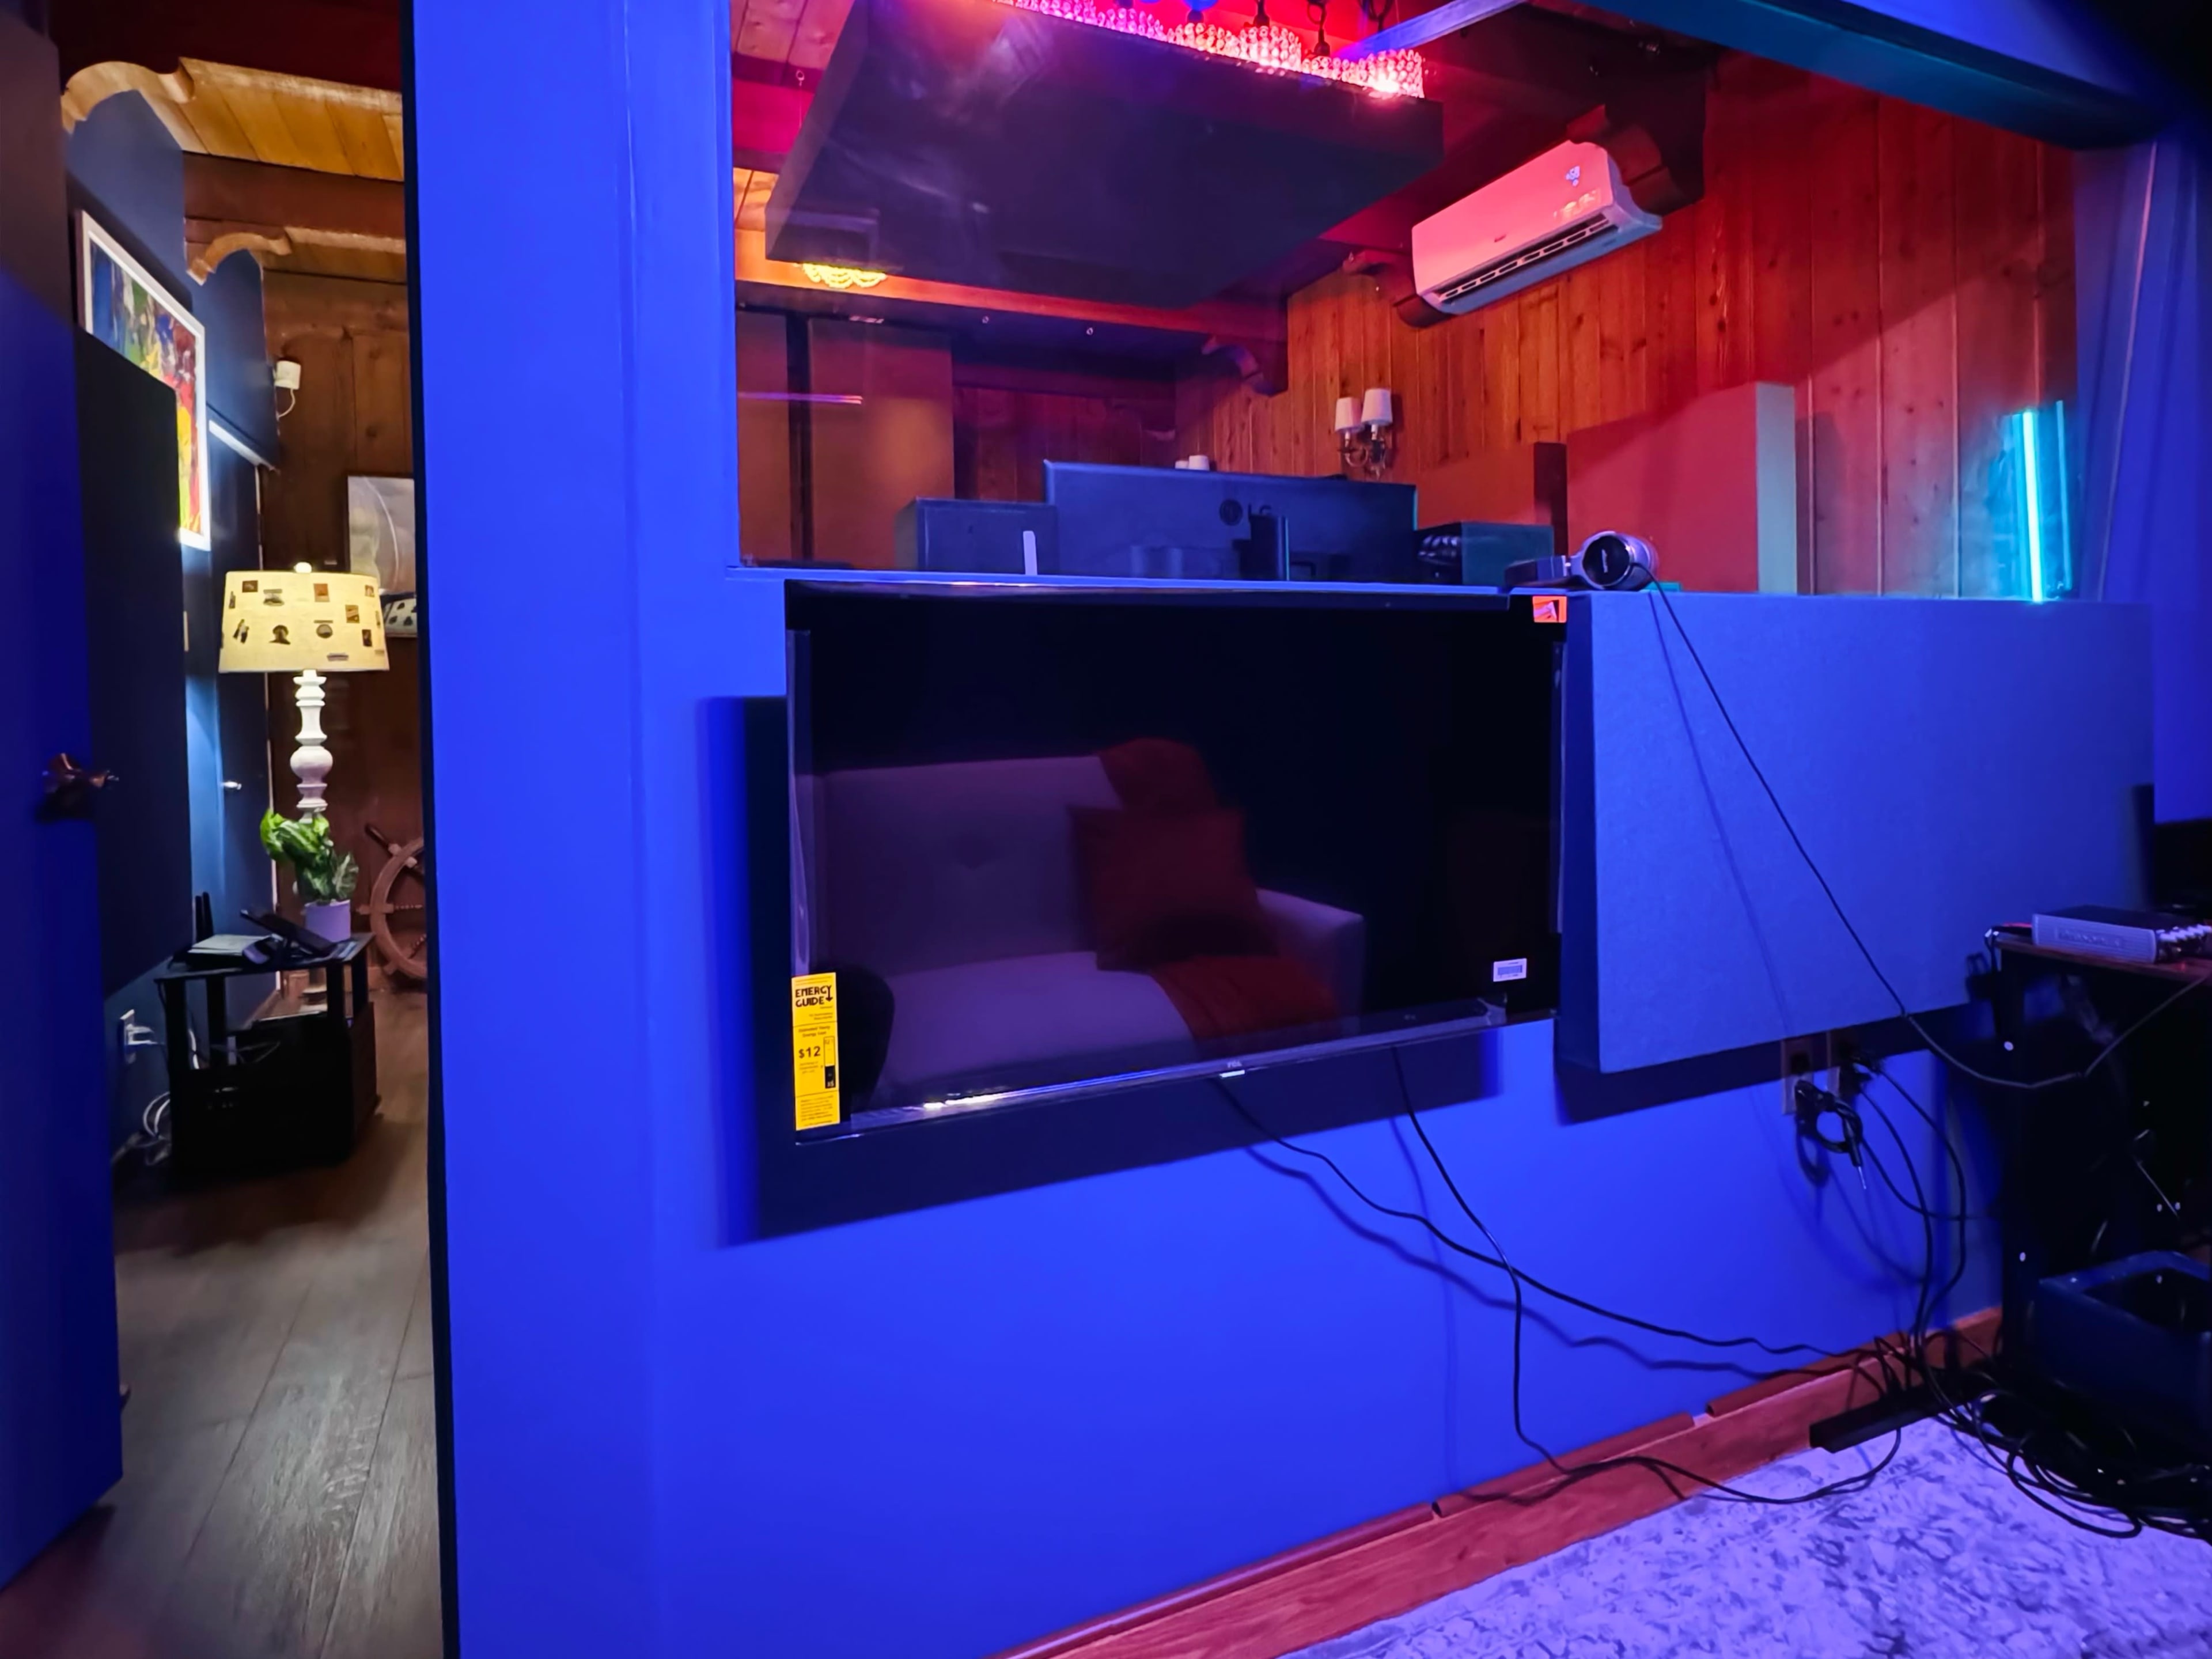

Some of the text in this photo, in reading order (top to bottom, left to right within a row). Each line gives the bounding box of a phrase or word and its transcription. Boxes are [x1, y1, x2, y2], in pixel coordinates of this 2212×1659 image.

[795, 985, 832, 998] ENERGY
[796, 996, 825, 1007] GUIDE
[798, 1046, 821, 1059] $12
